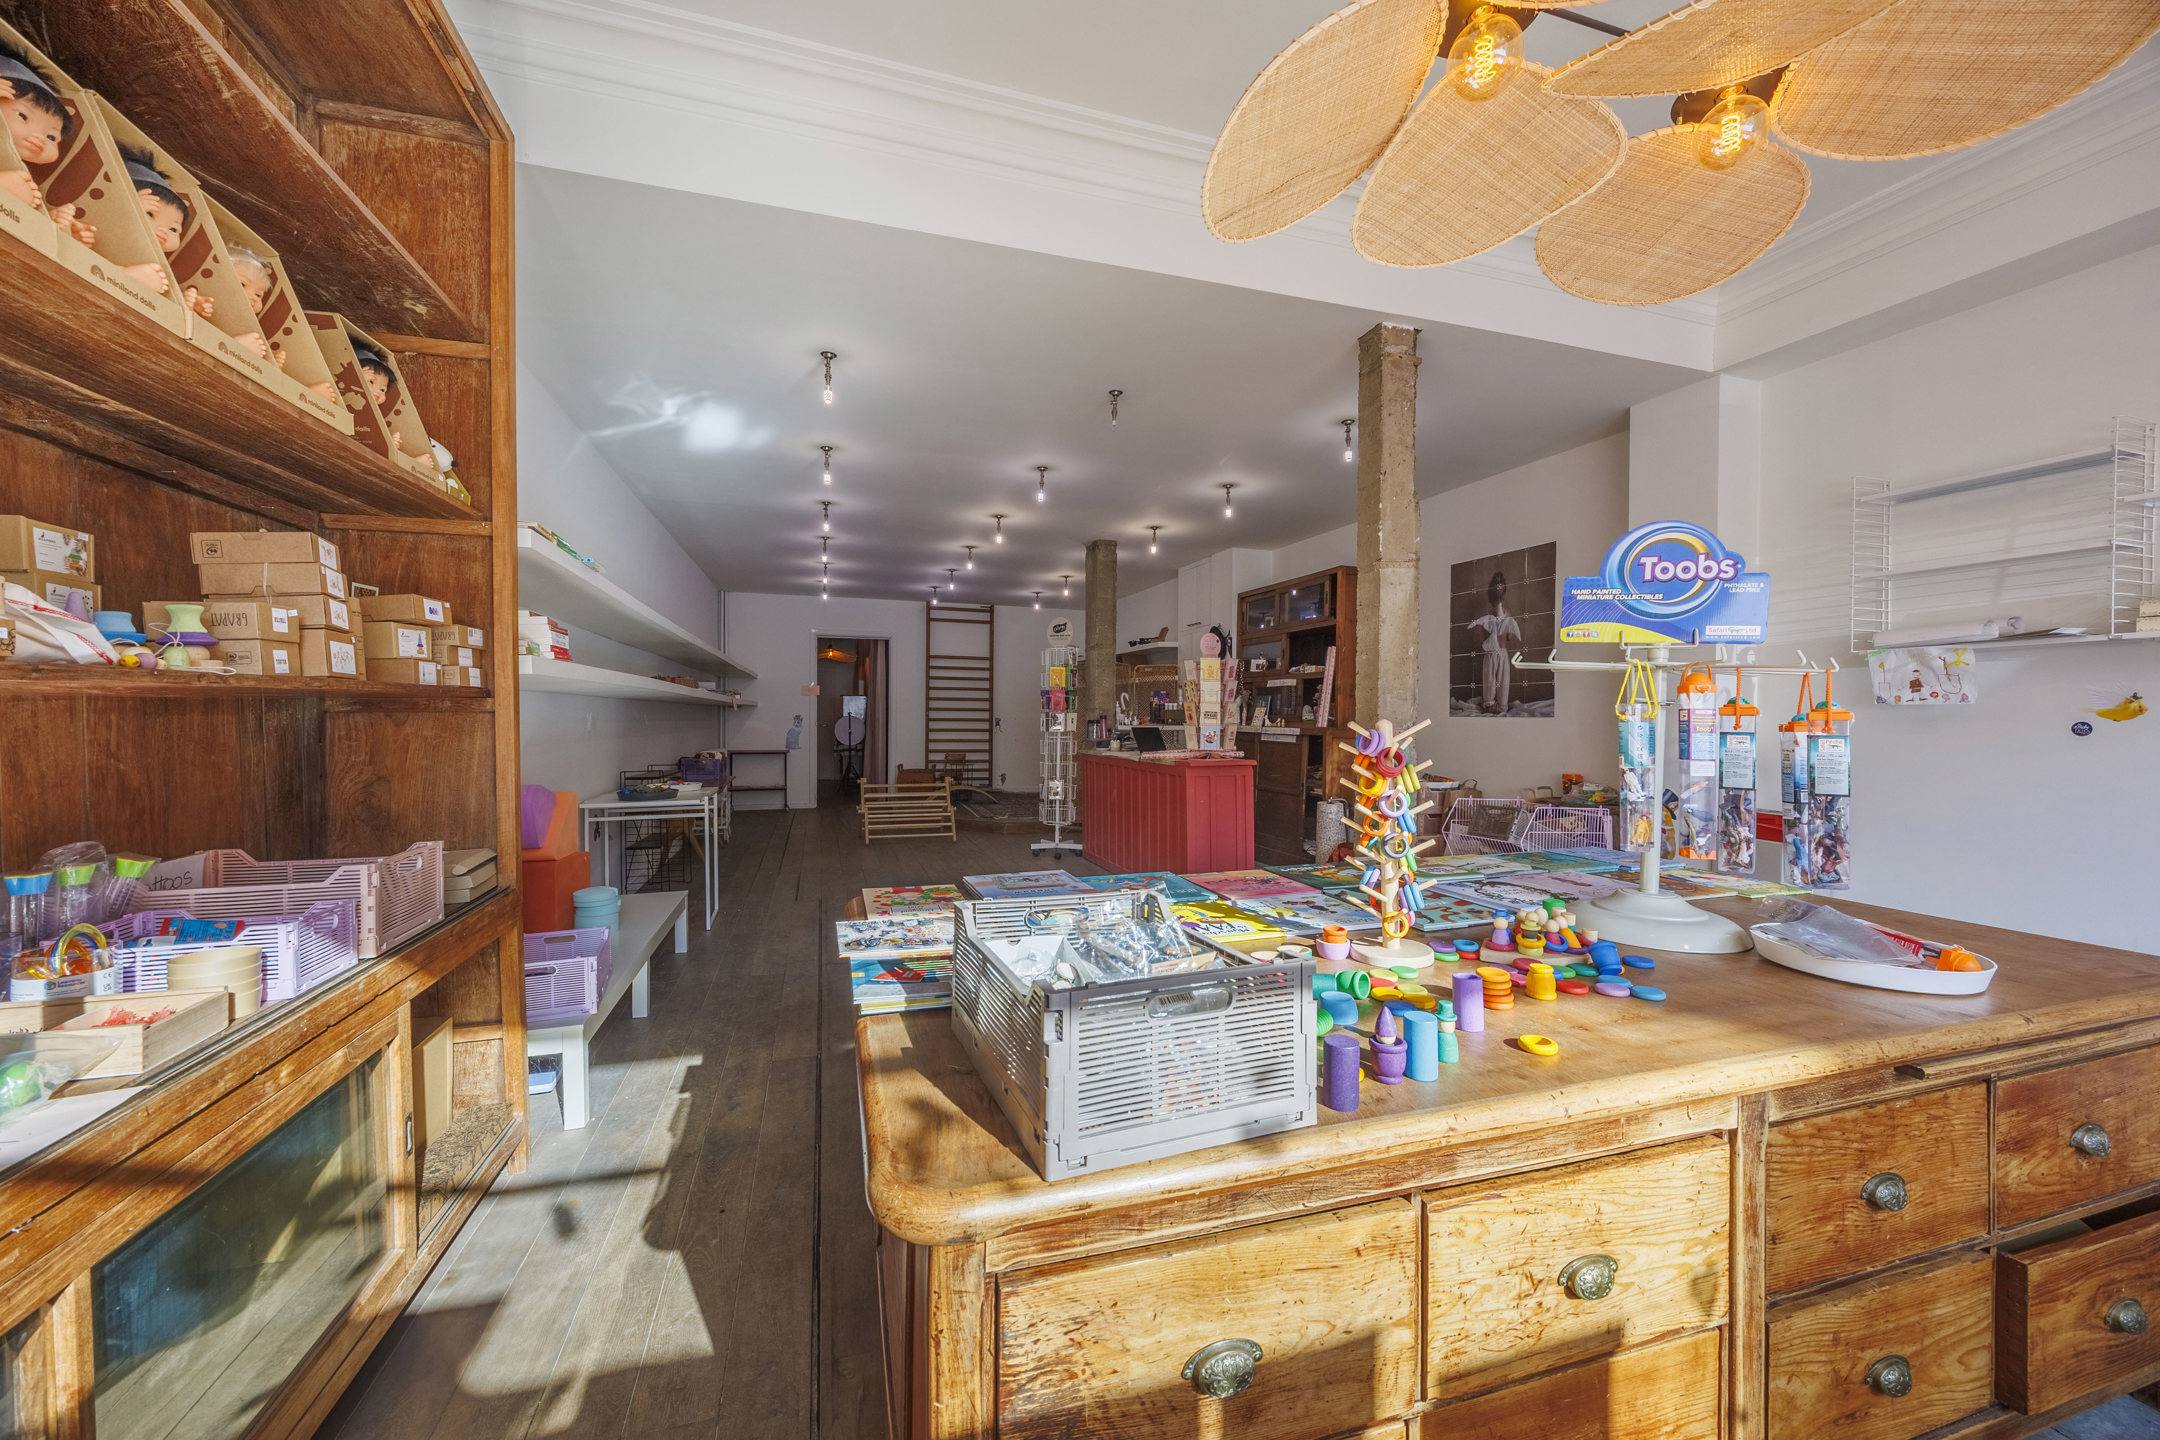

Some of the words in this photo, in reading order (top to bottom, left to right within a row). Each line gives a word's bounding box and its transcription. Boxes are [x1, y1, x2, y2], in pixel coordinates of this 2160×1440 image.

[106, 276, 139, 300] miniland
[139, 296, 156, 311] dolls
[1639, 553, 1737, 582] Toobs
[209, 612, 248, 627] GRAPAT
